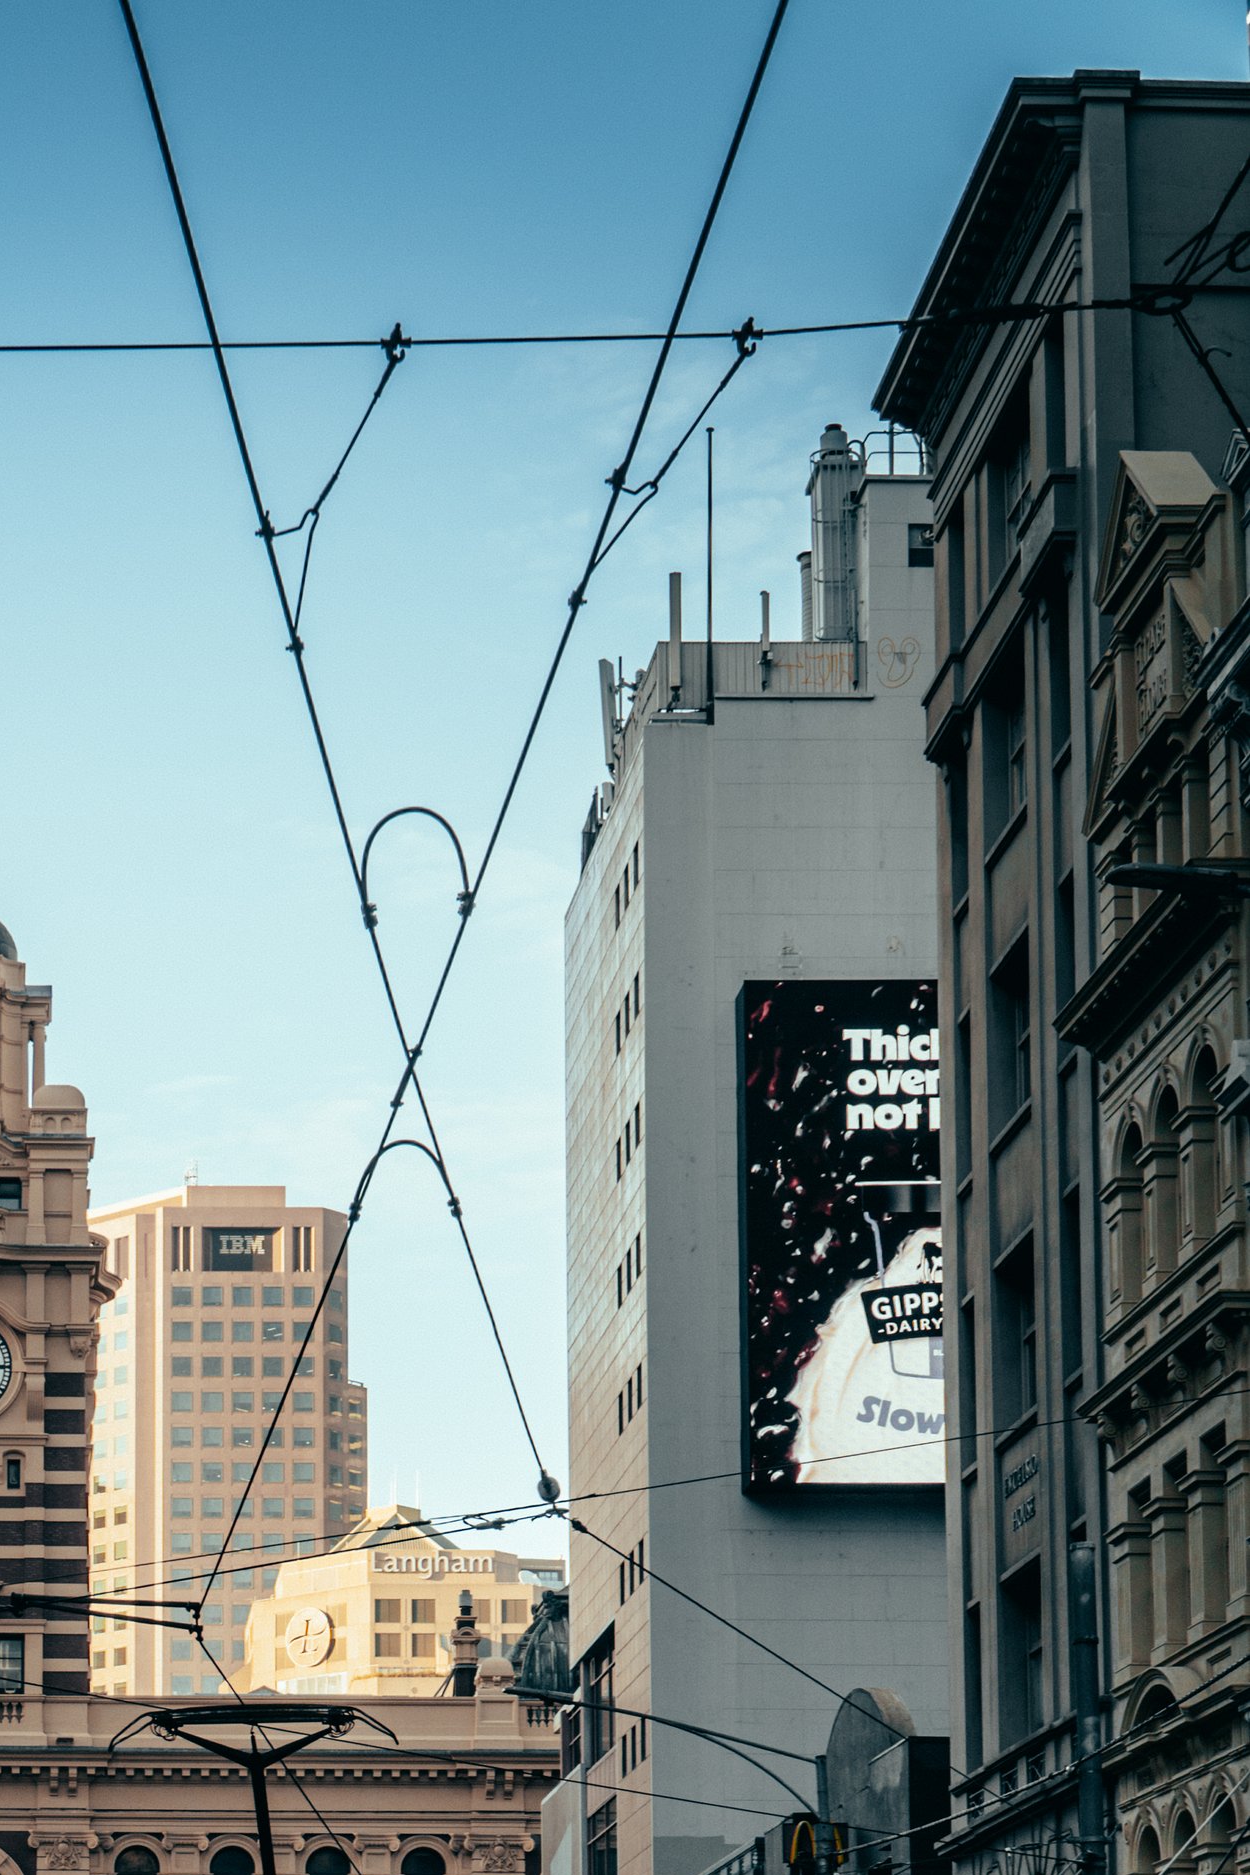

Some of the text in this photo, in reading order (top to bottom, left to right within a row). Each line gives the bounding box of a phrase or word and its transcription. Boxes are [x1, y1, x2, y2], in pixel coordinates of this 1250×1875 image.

[846, 1098, 922, 1130] not
[219, 1235, 265, 1254] IBM
[871, 1292, 943, 1320] GIPP
[856, 1395, 945, 1435] Slow
[371, 1551, 494, 1580] Langham
